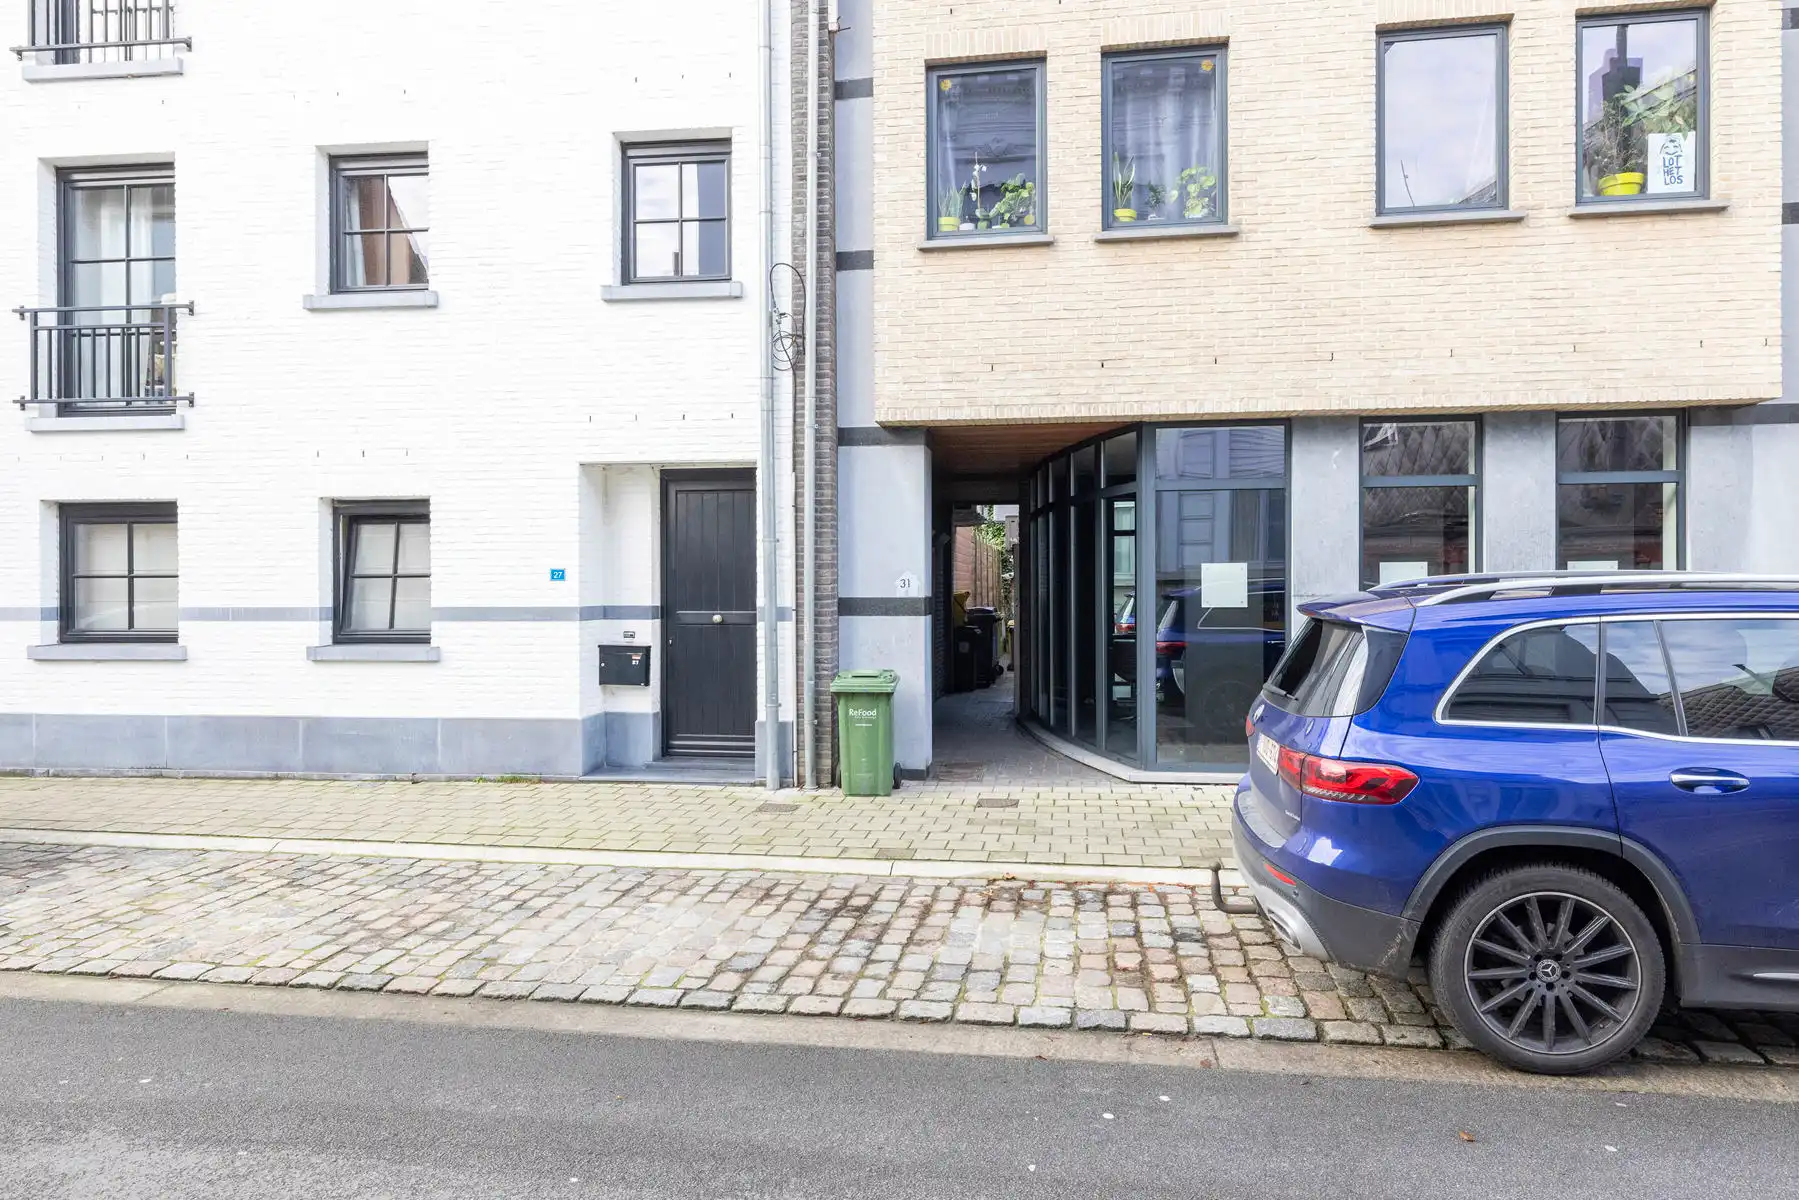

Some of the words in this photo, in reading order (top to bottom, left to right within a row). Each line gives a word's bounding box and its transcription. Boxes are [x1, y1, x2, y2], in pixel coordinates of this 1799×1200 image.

[1662, 154, 1683, 168] LOT
[1663, 166, 1682, 177] HET
[1664, 175, 1684, 186] LOS
[899, 578, 911, 589] 31
[848, 708, 877, 717] ReFood
